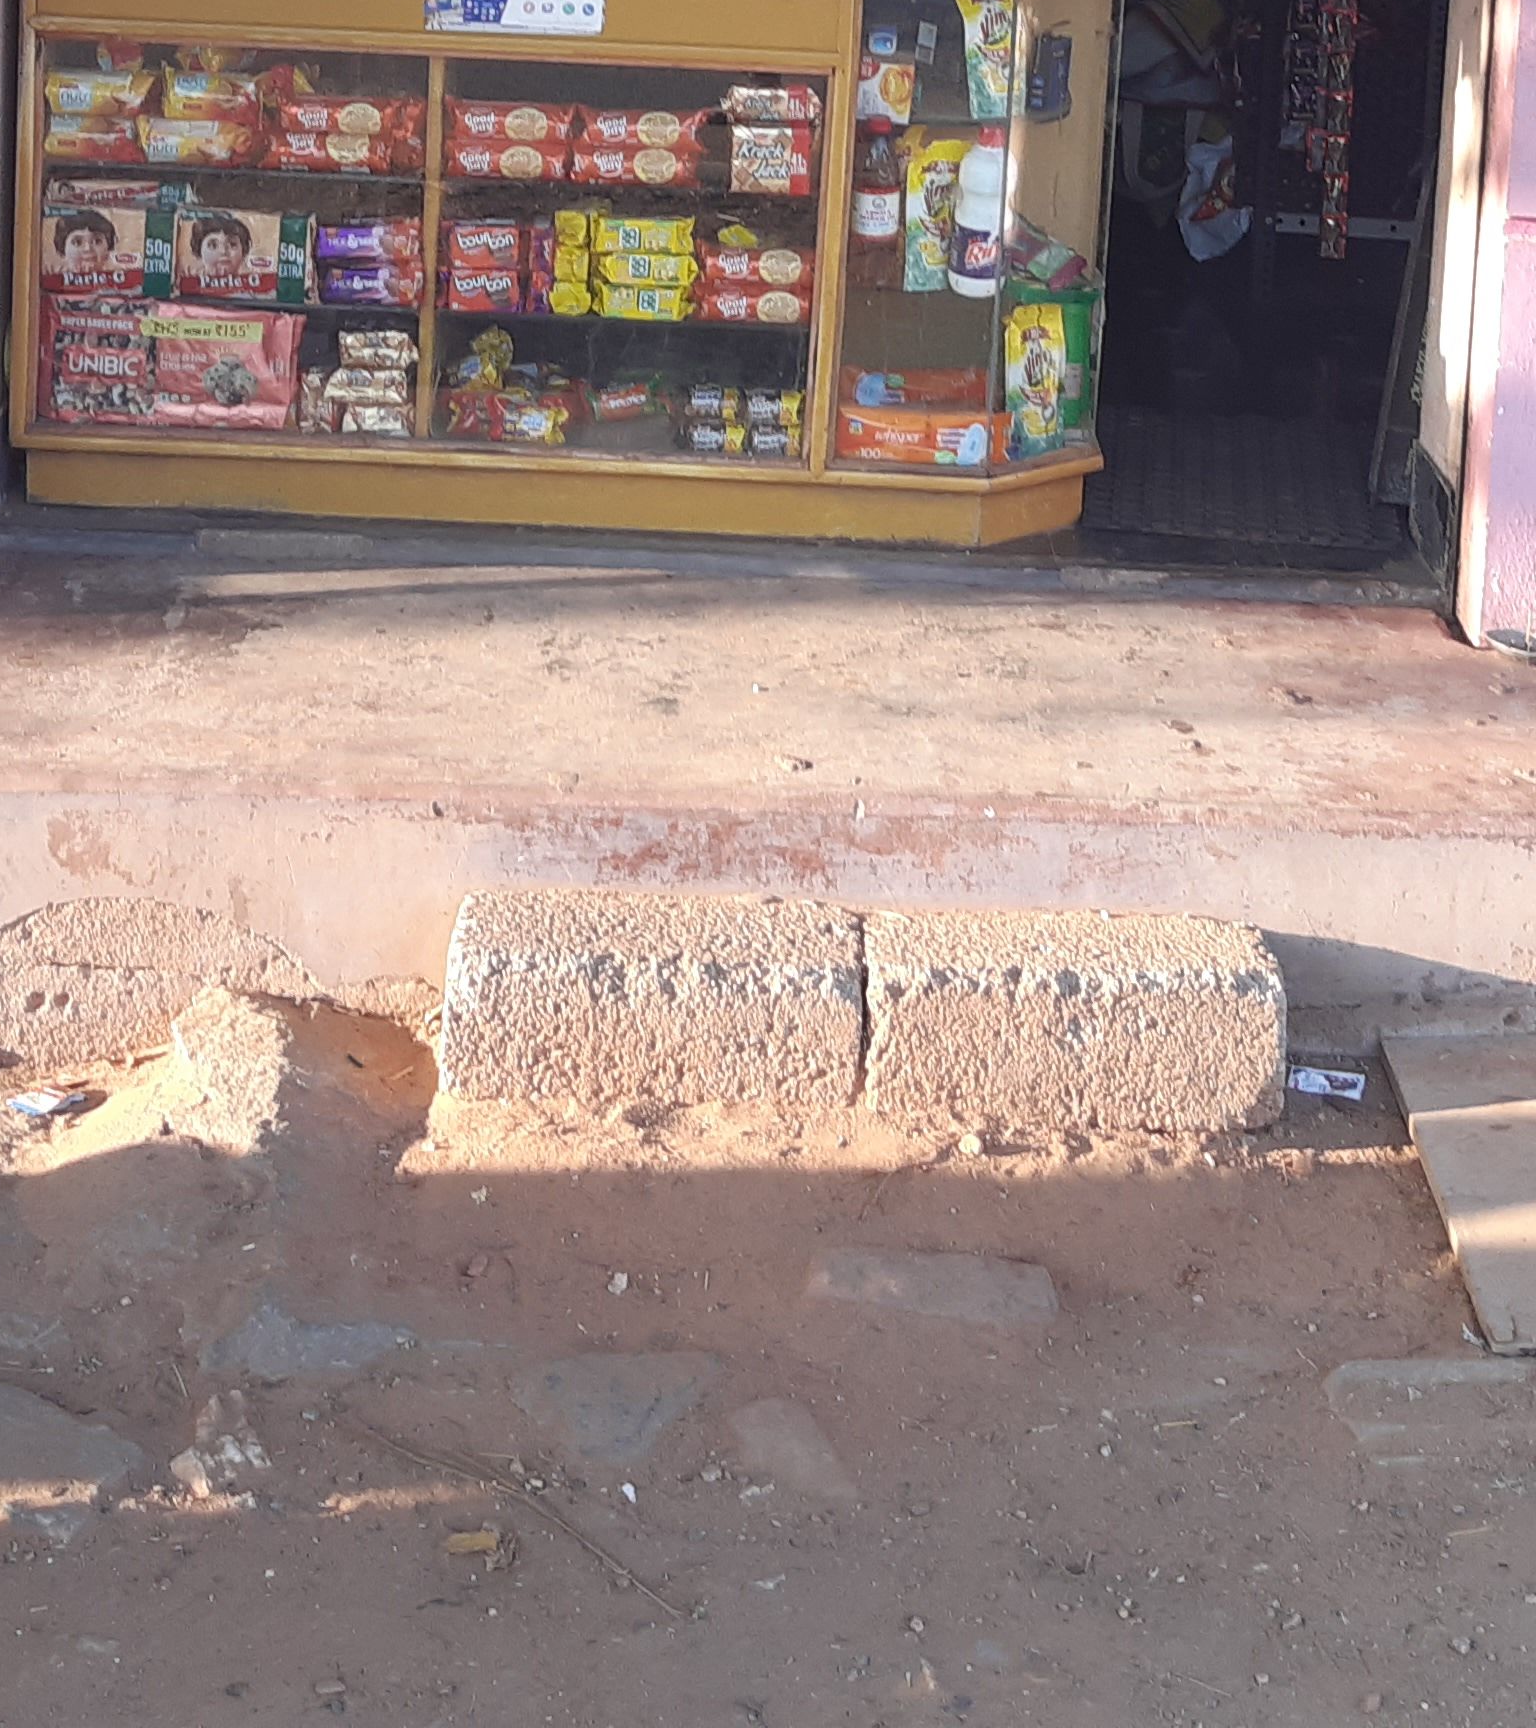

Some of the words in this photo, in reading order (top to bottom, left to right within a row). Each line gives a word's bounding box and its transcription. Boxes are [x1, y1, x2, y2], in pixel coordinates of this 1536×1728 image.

[464, 112, 496, 124] Good
[596, 116, 627, 128] Good
[459, 151, 490, 163] Good
[593, 151, 624, 163] Good
[145, 237, 172, 260] 50g
[456, 231, 515, 251] bourbon
[279, 244, 305, 265] 50g
[718, 251, 749, 264] Good
[144, 258, 171, 274] EXTRA
[278, 263, 304, 279] EXTRA
[454, 273, 512, 293] bourbon
[716, 295, 747, 308] Good
[67, 351, 140, 377] UNIBIC
